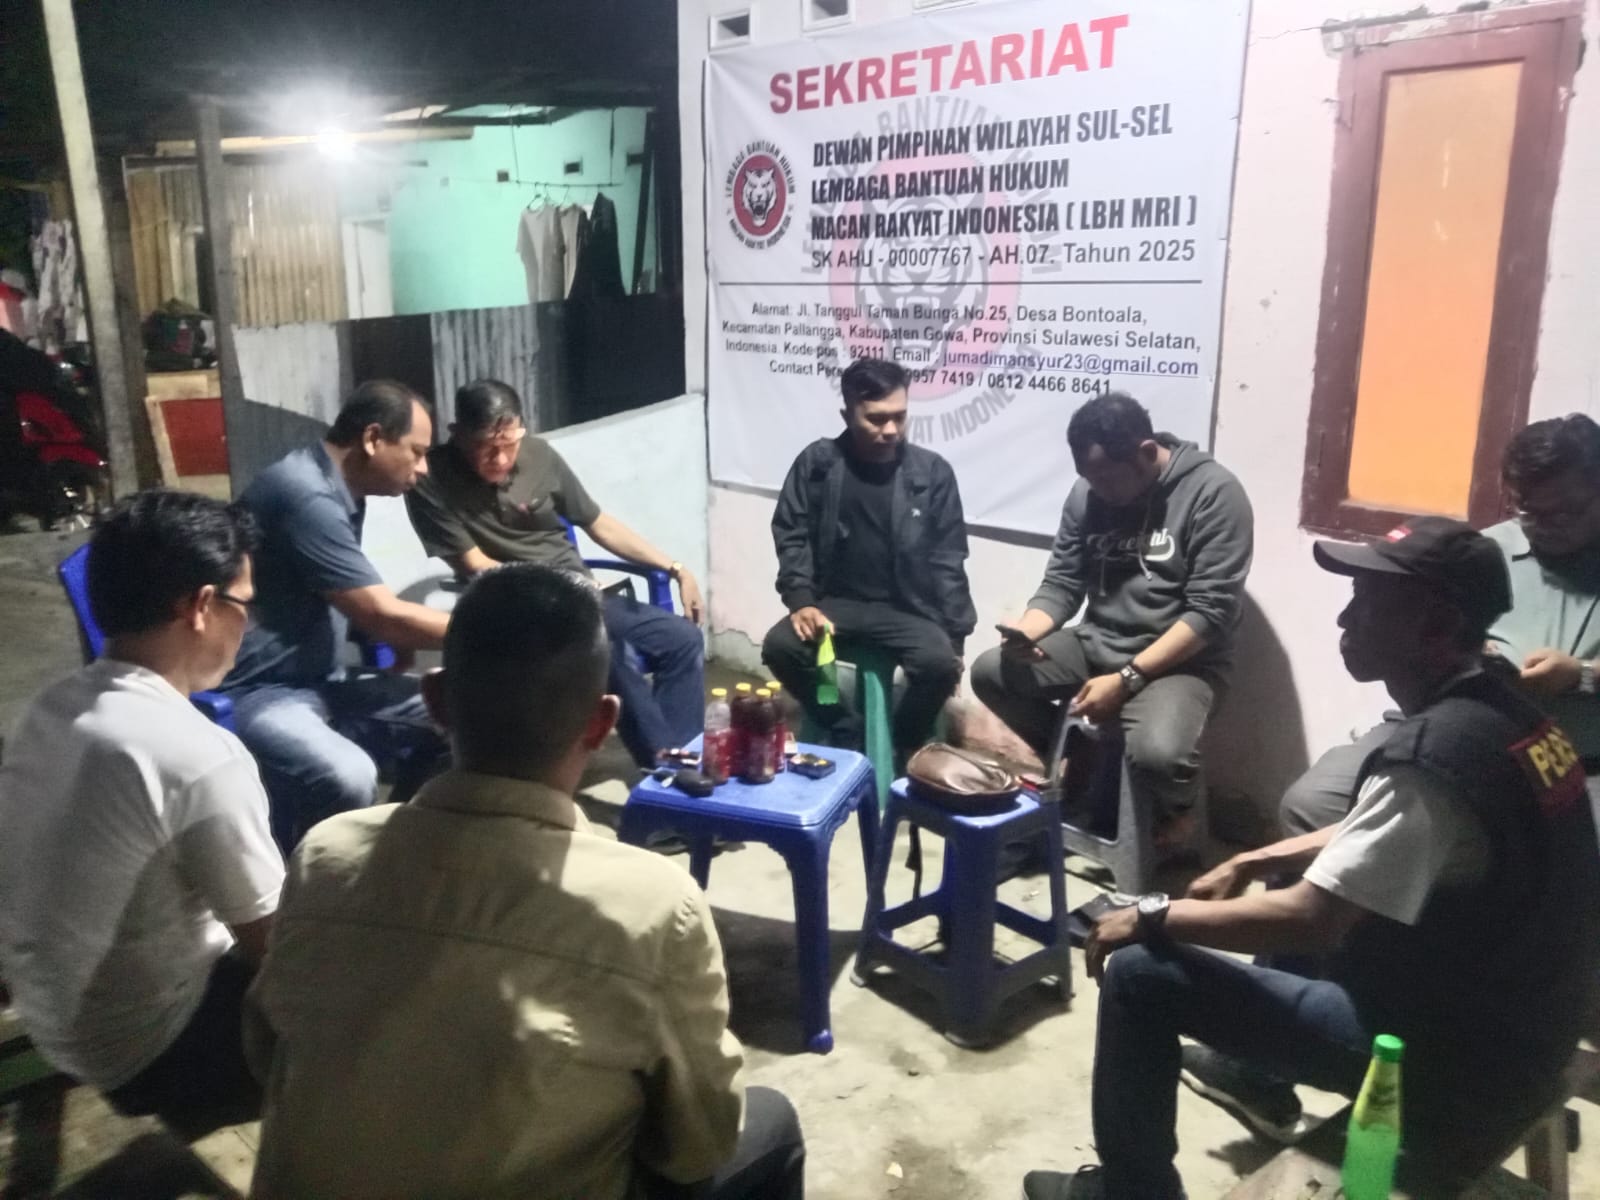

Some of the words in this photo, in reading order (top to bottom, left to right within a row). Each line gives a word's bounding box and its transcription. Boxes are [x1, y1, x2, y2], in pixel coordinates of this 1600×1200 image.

[769, 14, 1129, 114] SEKRETARIAT
[813, 136, 873, 167] DEWAN
[877, 125, 971, 161] PIMPINAN
[976, 114, 1071, 152] WILAYAH
[1076, 103, 1173, 143] SUL-SEL
[811, 173, 891, 204] LEMBAGA
[894, 165, 984, 199] BANTUAN
[989, 158, 1070, 193] HUKUM
[811, 213, 871, 241] MACAN
[874, 210, 944, 238] RAKYAT
[948, 202, 1060, 236] INDONESIA
[1079, 198, 1126, 230] LBH
[1130, 195, 1181, 229] MRI
[811, 250, 833, 268] SK
[836, 249, 873, 268] AHU
[888, 246, 972, 267] 00007767
[1063, 242, 1131, 264] Tahun
[1138, 239, 1196, 262] 2025
[814, 303, 862, 321] Tanggul
[865, 304, 909, 319] Taman
[913, 305, 959, 323] Bunga
[963, 305, 1011, 324] No.25,
[1016, 305, 1057, 321] Desa
[1062, 305, 1147, 326] Bontoala,
[722, 320, 781, 335] Kecamatan
[784, 322, 845, 341] Pallangga,
[849, 324, 919, 342] Kabupaten
[923, 326, 968, 344] Gowa,
[972, 327, 1037, 345] Provinsi
[1041, 328, 1119, 347] Sulawesi
[1125, 330, 1200, 353] Selatan,
[893, 346, 930, 362] Email
[769, 360, 813, 376] Contact
[940, 370, 975, 387] 7419
[987, 372, 1023, 389] 0812
[1027, 374, 1067, 393] 4466
[1071, 376, 1111, 397] 8641
